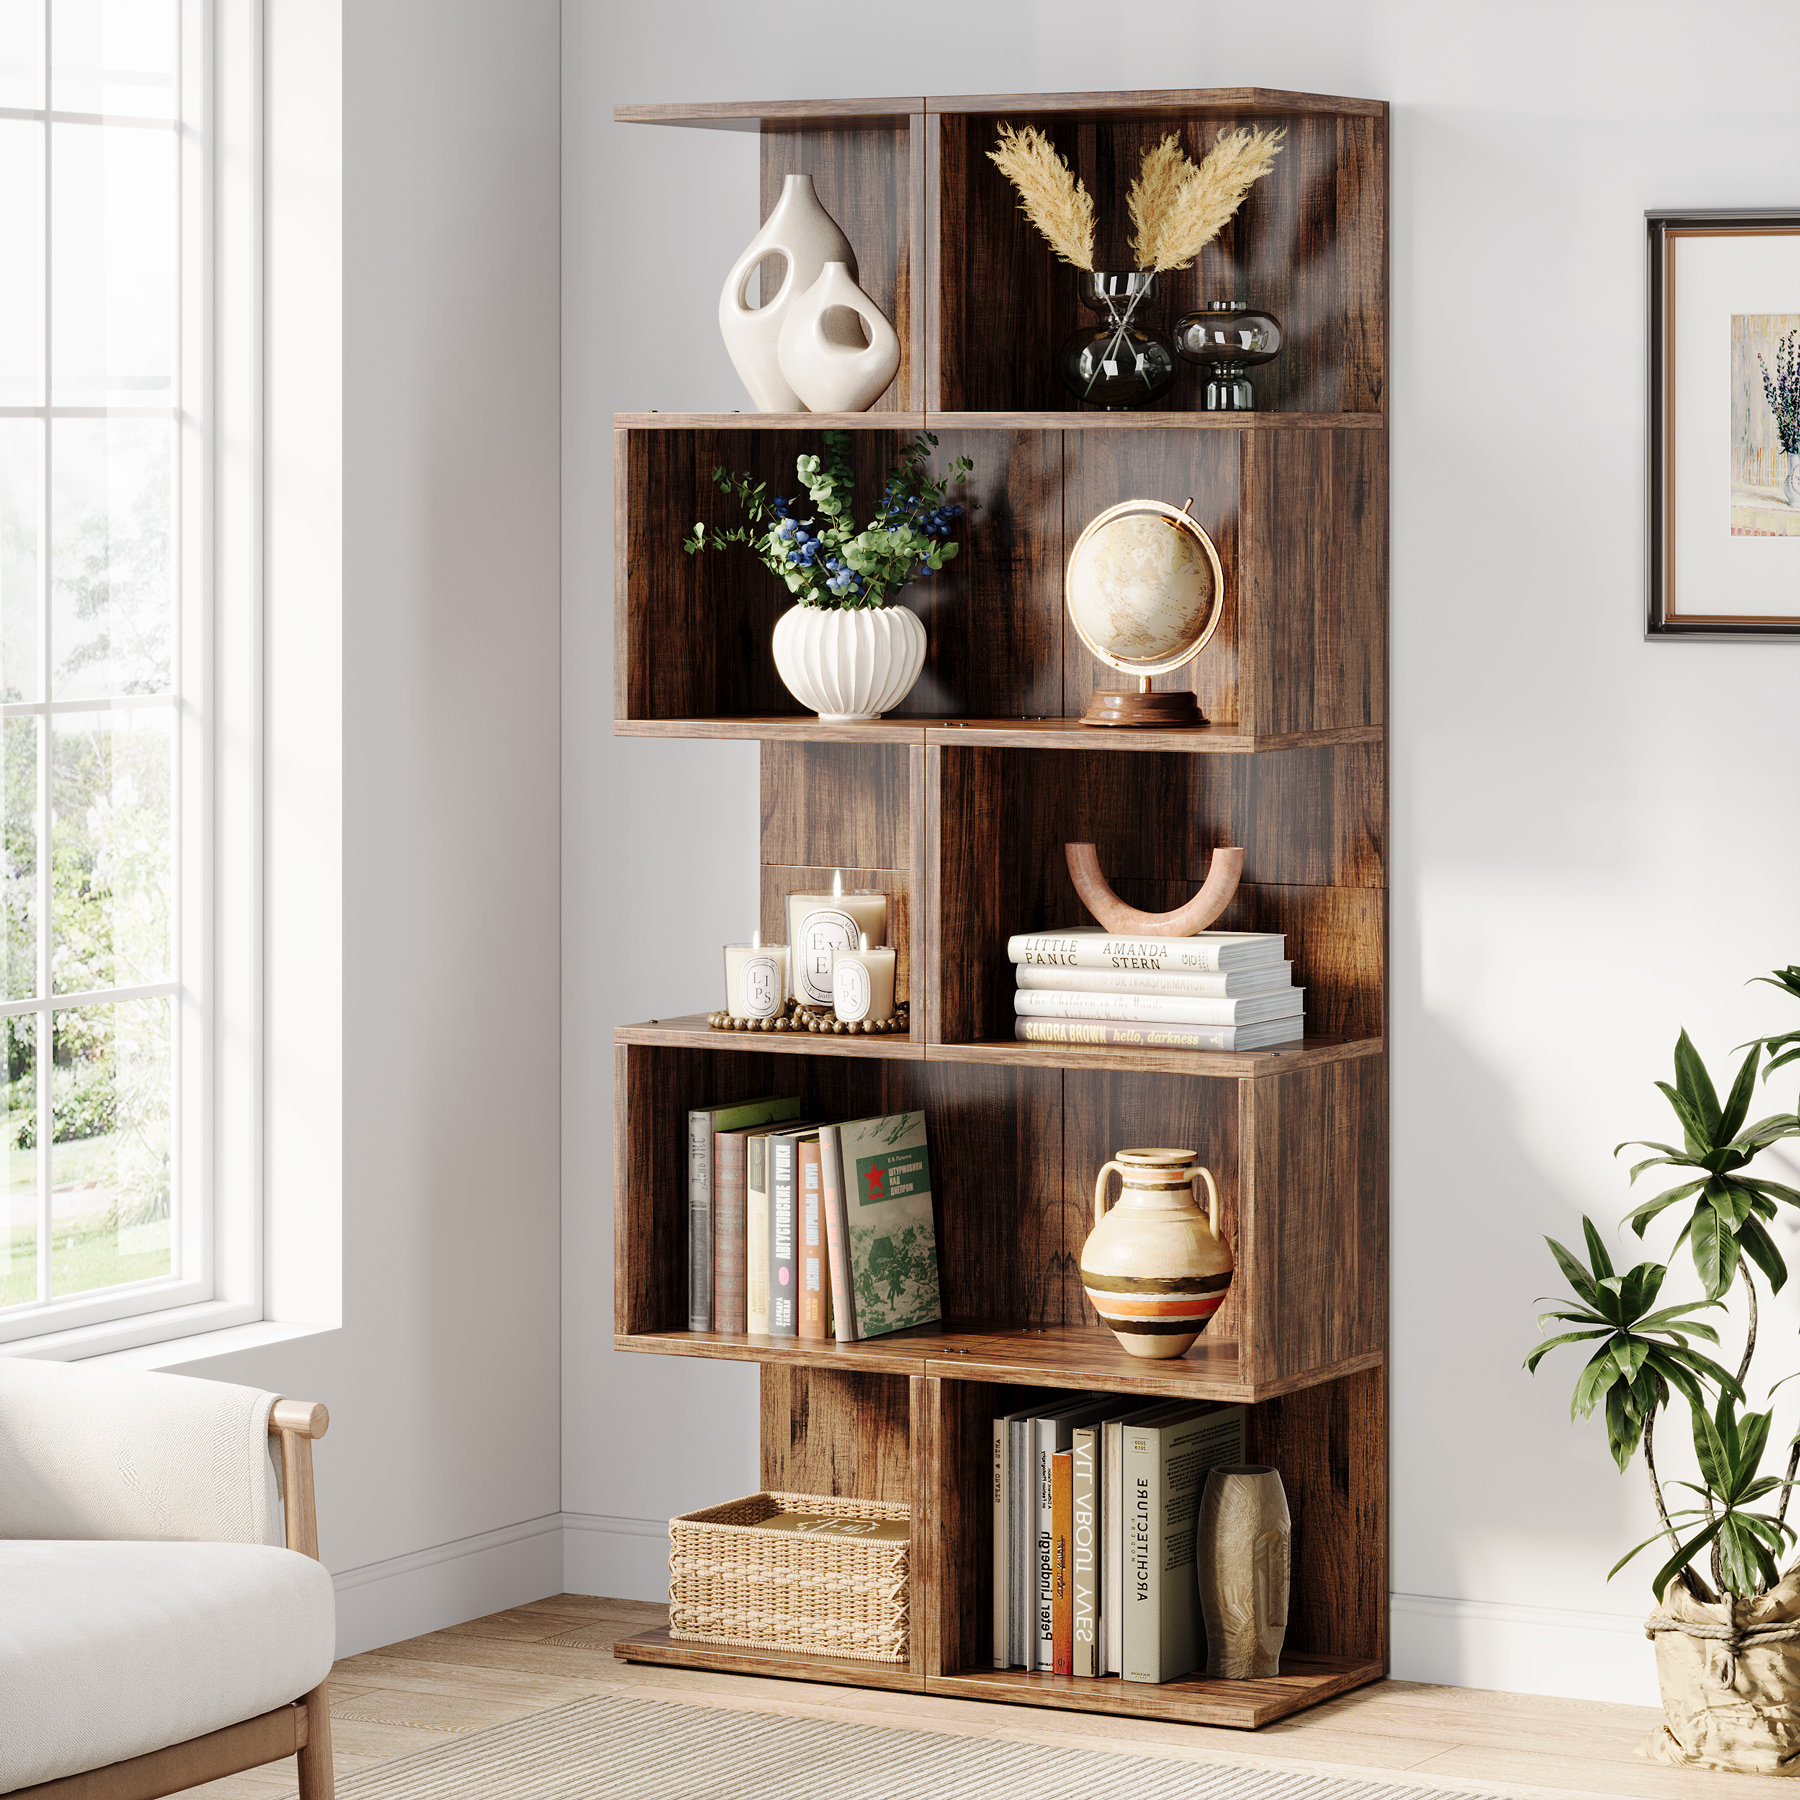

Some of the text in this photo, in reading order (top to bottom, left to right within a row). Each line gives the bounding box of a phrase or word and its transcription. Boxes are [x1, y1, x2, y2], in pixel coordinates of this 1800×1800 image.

[1025, 938, 1079, 953] LITTLE
[1103, 942, 1168, 957] AMANDA
[1025, 952, 1078, 966] PANIC
[1111, 956, 1161, 970] STERN
[1026, 1022, 1068, 1042] SANDRA
[1069, 1024, 1107, 1043] BROWN
[1113, 1029, 1145, 1045] hello,
[1147, 1031, 1199, 1046] darkness
[775, 1144, 791, 1260] АВГУСТОВСКИЕ ПУШКИ
